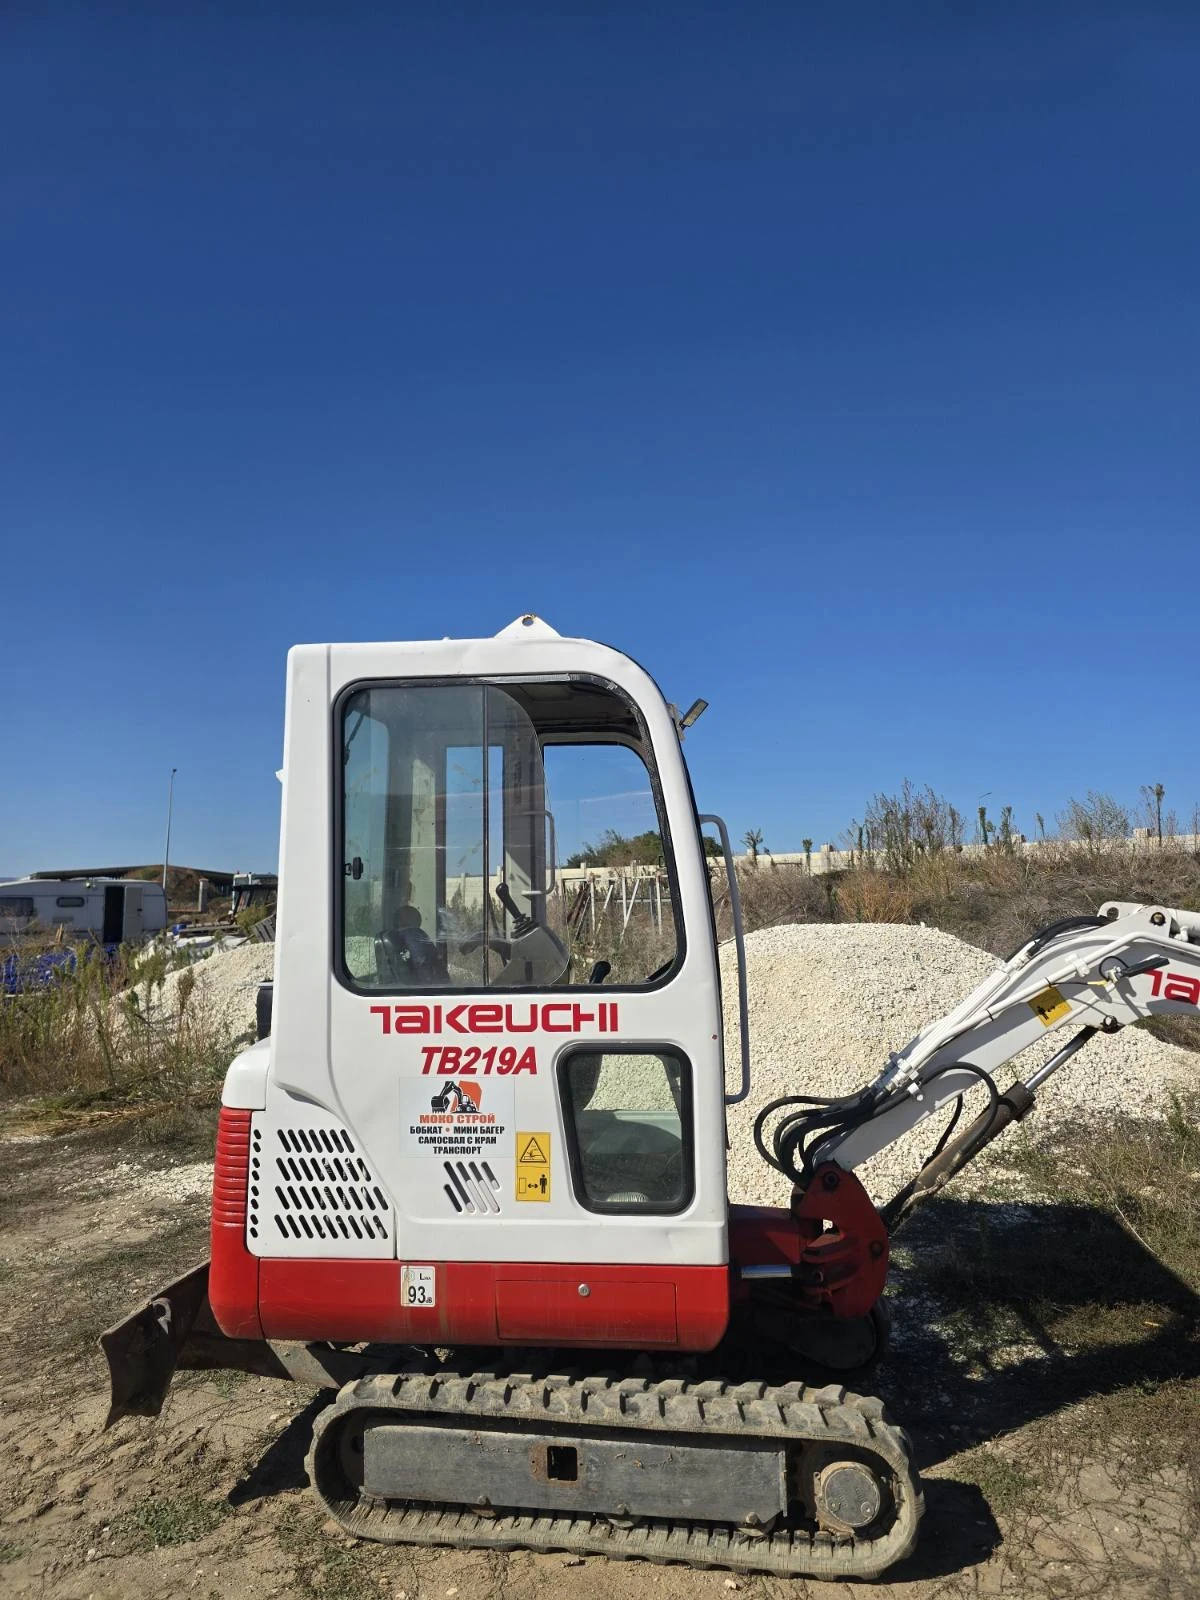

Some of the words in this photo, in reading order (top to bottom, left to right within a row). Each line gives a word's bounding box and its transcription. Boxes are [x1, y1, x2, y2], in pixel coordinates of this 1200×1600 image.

[421, 1046, 537, 1075] TB219A
[457, 1113, 496, 1123] СТРОЙ
[410, 1126, 442, 1134] БОБКАТ
[453, 1126, 478, 1134] МИНИ
[480, 1126, 505, 1134] БАГЕР
[418, 1136, 465, 1144] САМОСВАЛ
[467, 1136, 472, 1144] С
[475, 1136, 497, 1144] КРАН
[433, 1146, 482, 1154] ТРАНСПОРТ
